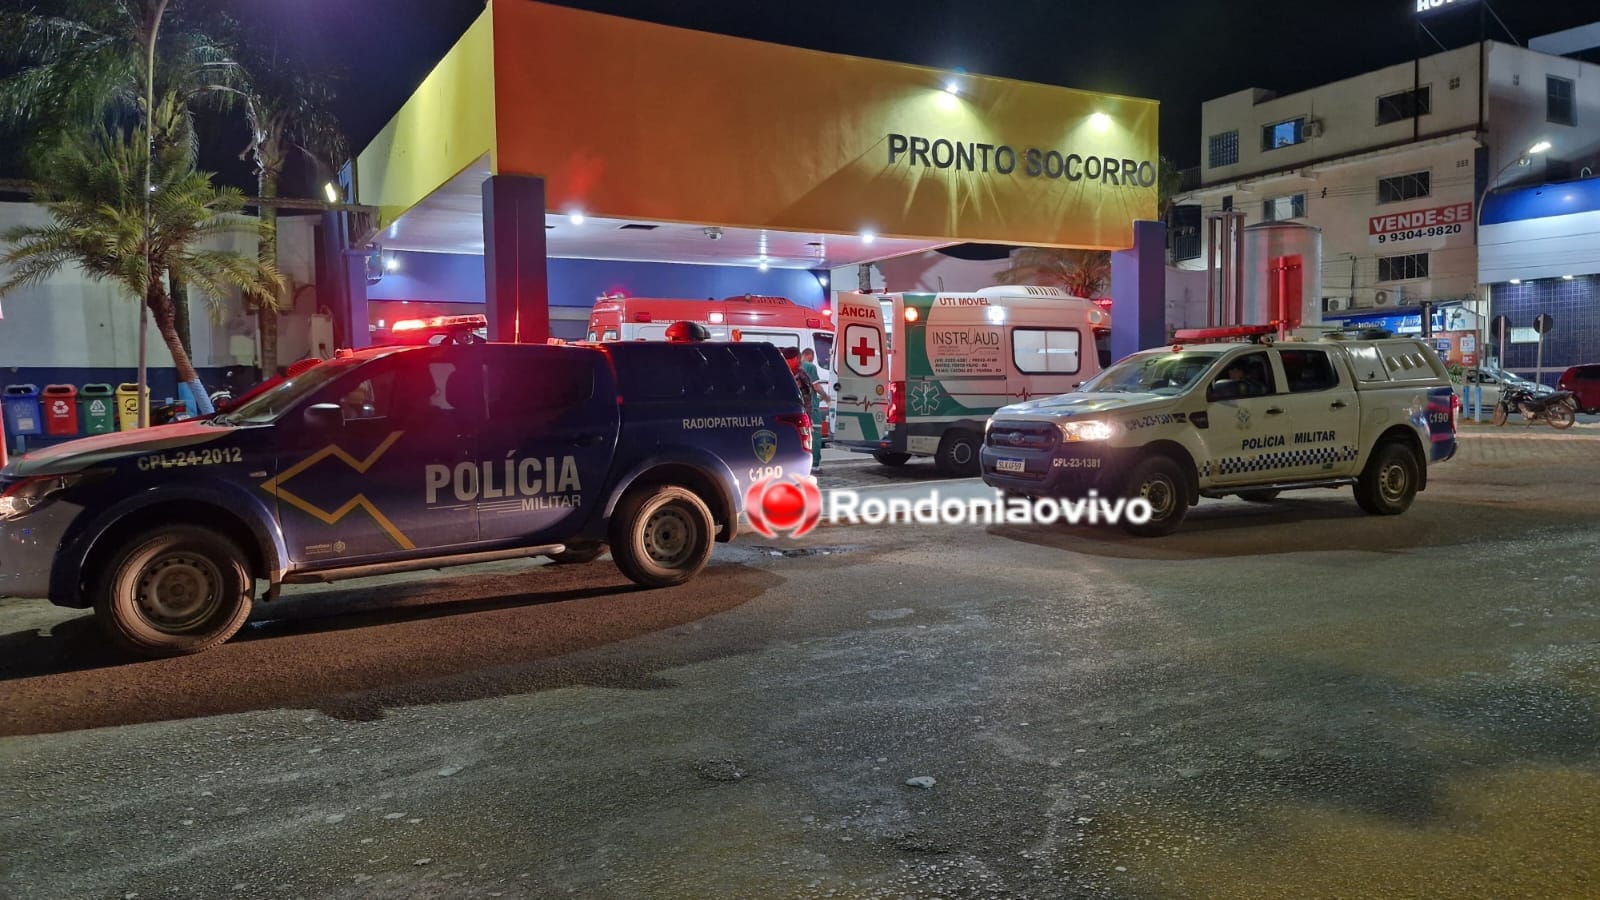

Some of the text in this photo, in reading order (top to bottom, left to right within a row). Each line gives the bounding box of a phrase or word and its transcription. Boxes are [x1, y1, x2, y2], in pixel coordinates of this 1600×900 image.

[888, 133, 1157, 188] PRONTO SOCORRO
[1372, 204, 1470, 233] VENDE-SE
[1378, 223, 1462, 244] 9 9304-9820
[939, 297, 956, 306] UTI
[682, 416, 765, 429] RADIOPATRULHA
[1434, 413, 1449, 423] 190
[1241, 430, 1336, 450] POLÍCIA MILITAR
[137, 447, 243, 472] CPL-24-2012
[1053, 458, 1101, 468] CPL-23-1381
[424, 450, 582, 503] POLÍCIA
[520, 494, 582, 512] MILITAR
